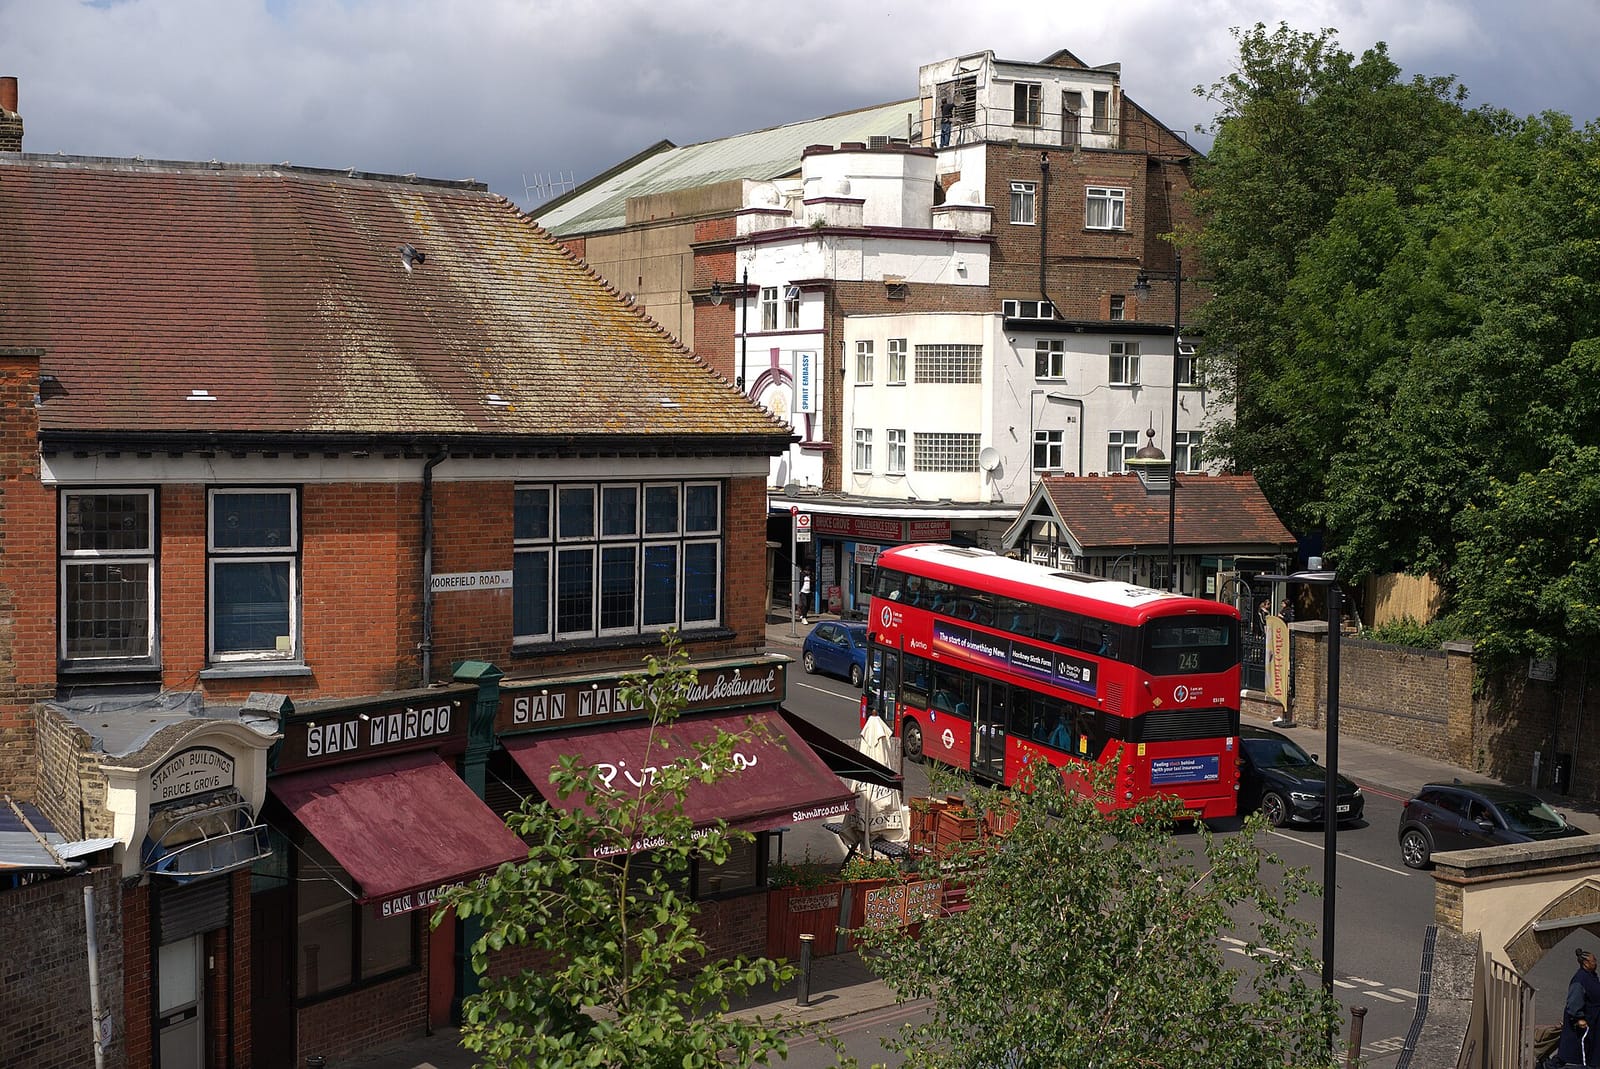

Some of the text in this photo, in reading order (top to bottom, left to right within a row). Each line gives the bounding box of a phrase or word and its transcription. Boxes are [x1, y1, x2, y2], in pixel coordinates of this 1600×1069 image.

[833, 518, 850, 530] GROVE
[479, 574, 501, 585] ROAD
[939, 631, 1006, 658] The start of something New.
[1012, 649, 1030, 662] Hackney
[1030, 654, 1041, 664] Sixth
[1041, 657, 1052, 667] Form
[1179, 653, 1198, 669] 243
[513, 693, 566, 724] SAN
[578, 683, 660, 717] MAR
[307, 705, 451, 757] SAN MARCO
[152, 752, 231, 791] STATION BUILDINGS
[162, 775, 220, 799] BRUCE GROVE
[382, 894, 412, 917] SAN
